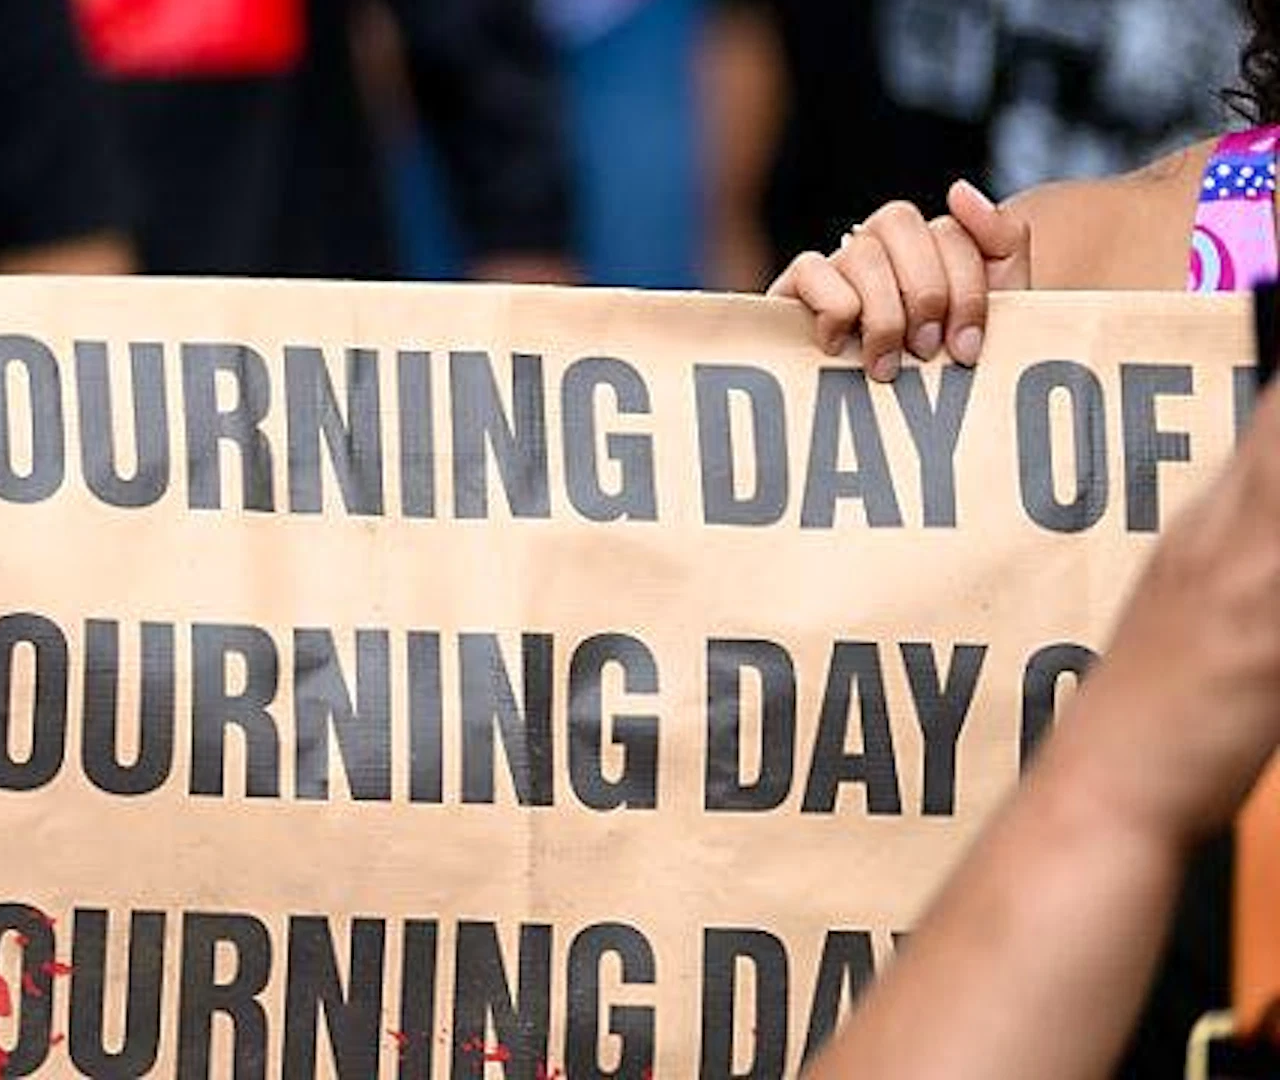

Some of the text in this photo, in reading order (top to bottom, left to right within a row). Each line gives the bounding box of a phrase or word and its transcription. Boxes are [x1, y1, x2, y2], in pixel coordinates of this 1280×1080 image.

[694, 362, 978, 529] DAY
[1015, 360, 1194, 534] OF
[704, 638, 988, 817] DAY
[700, 926, 912, 1080] DA
